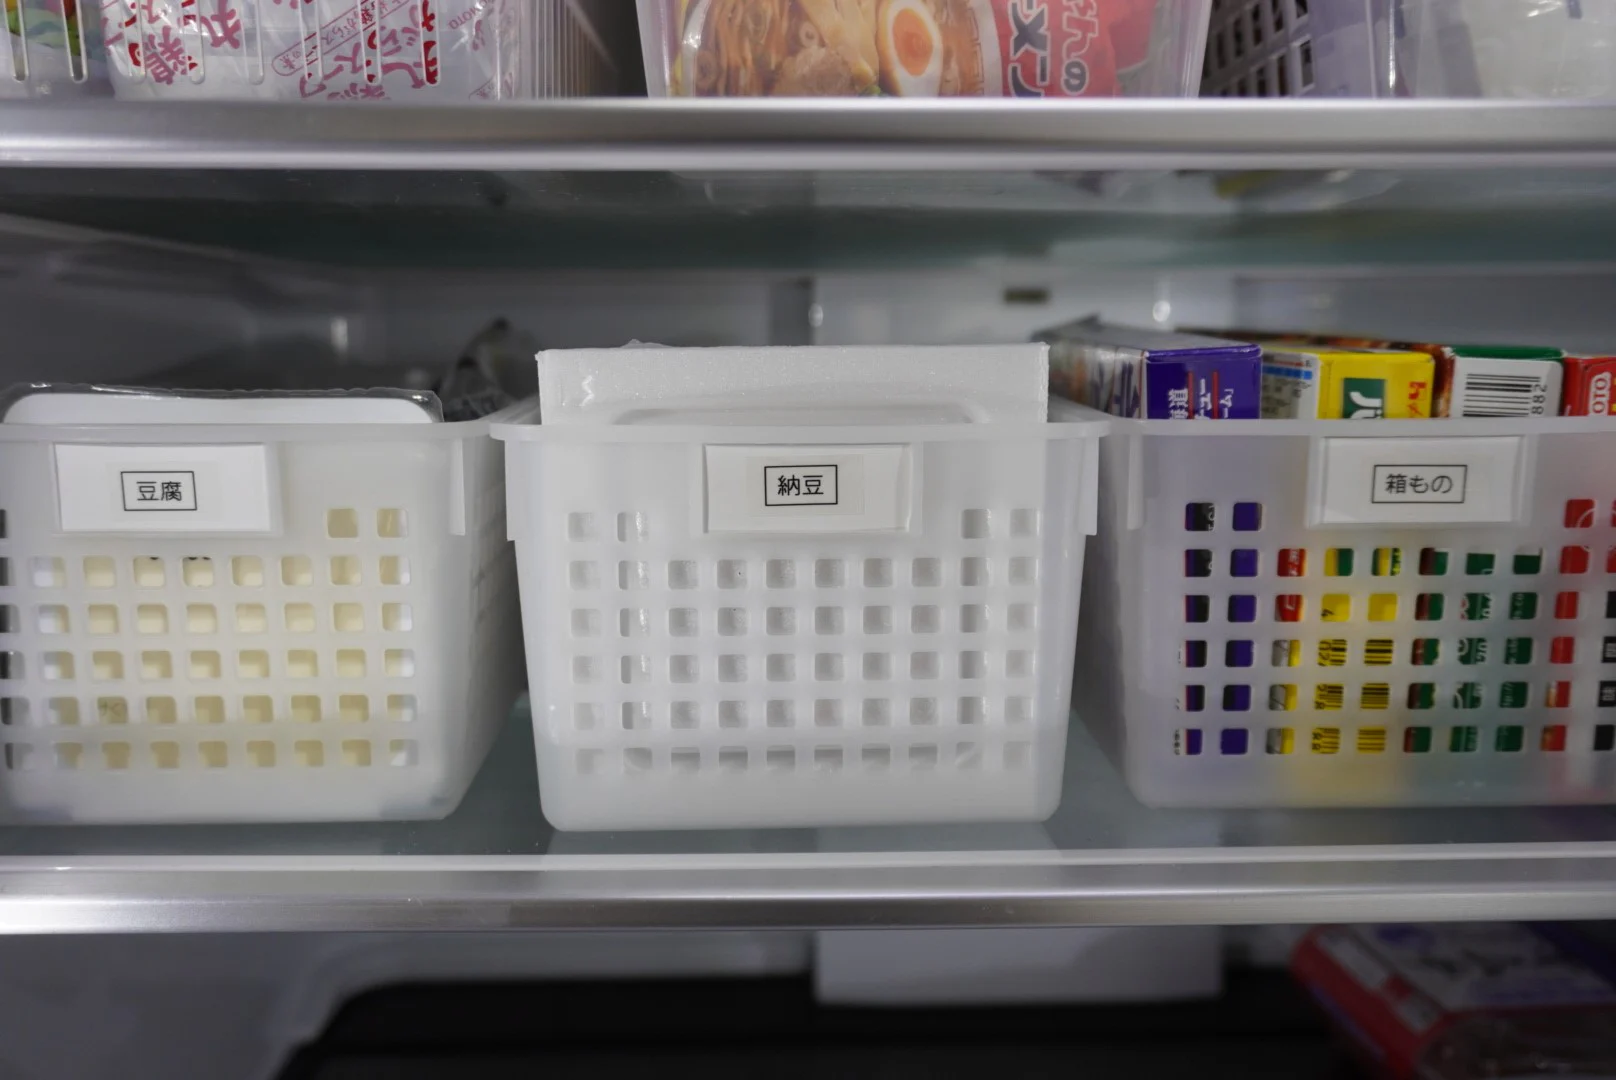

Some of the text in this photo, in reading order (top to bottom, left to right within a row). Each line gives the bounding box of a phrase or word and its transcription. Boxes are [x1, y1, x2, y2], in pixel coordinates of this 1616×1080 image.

[136, 480, 183, 502] 豆腐
[777, 474, 824, 496] 納豆
[1385, 473, 1453, 495] 箱もの
